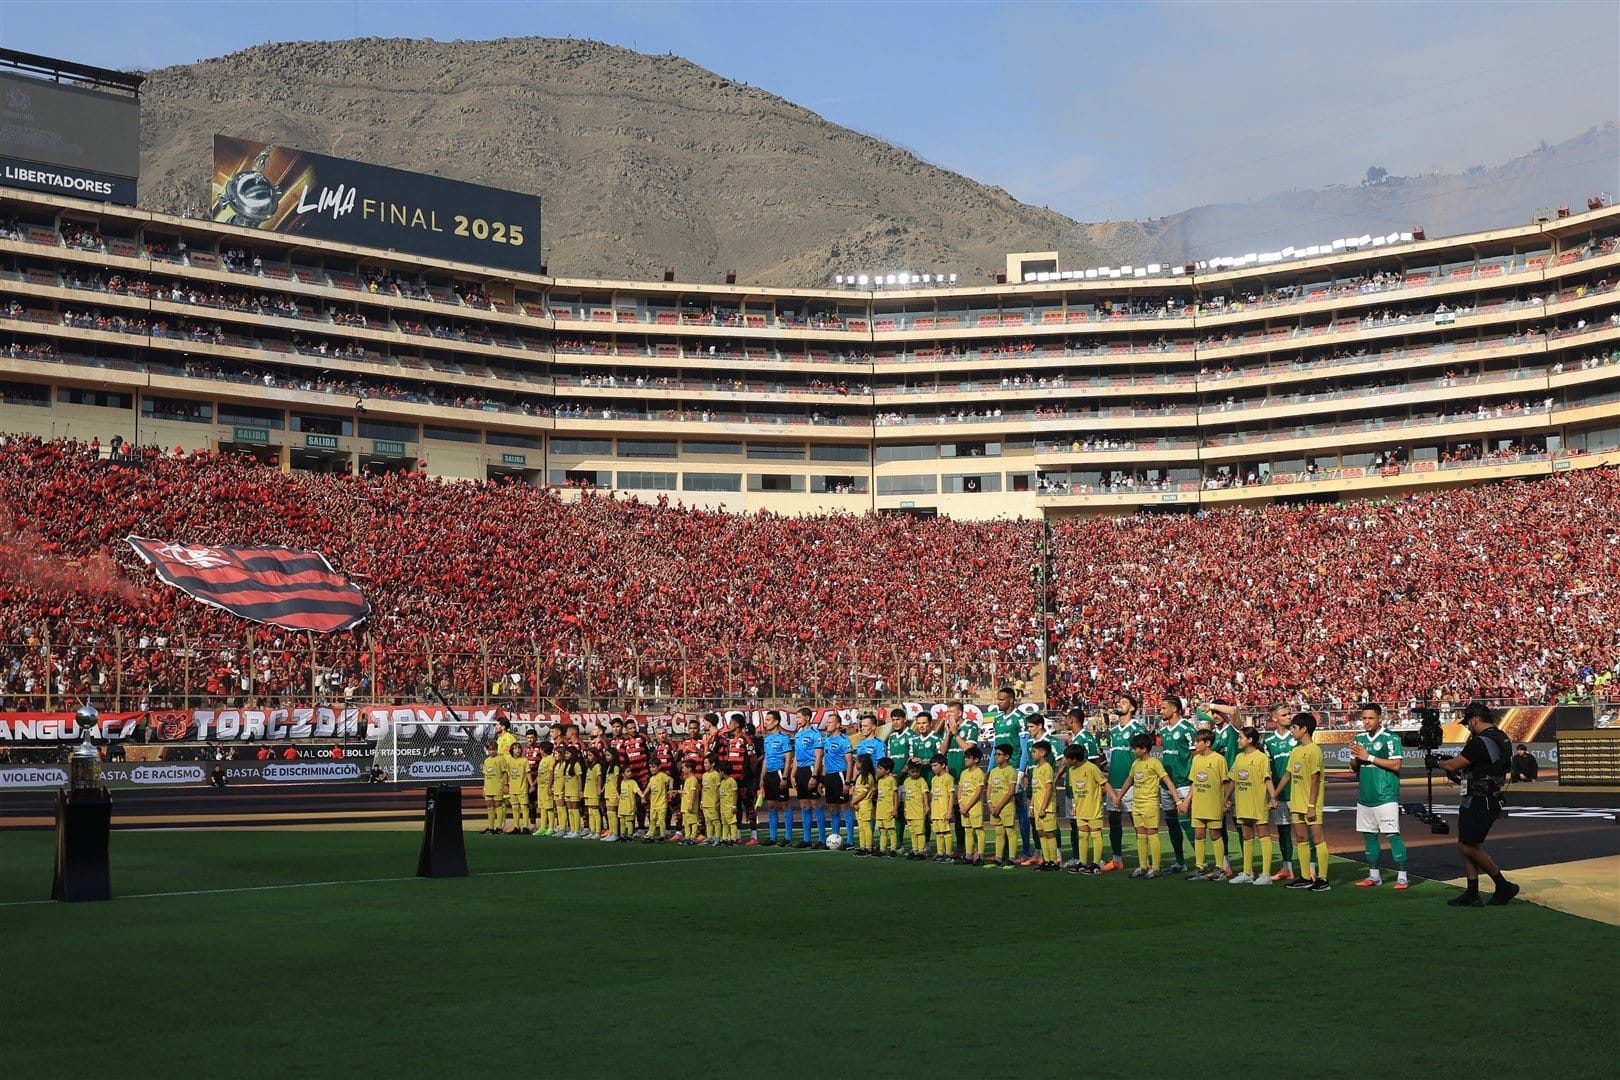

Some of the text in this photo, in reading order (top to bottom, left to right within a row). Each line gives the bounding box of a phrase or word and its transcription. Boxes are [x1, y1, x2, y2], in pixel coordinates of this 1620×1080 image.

[6, 166, 112, 194] LIBERTADORES
[296, 184, 524, 246] LIMA FINAL 2025
[237, 429, 266, 440] SALIDA
[308, 437, 336, 447] SALIDA
[376, 443, 402, 452] SALIDA
[226, 765, 358, 778] BASTA DE DISCRIMINACIÓN
[412, 765, 424, 773] DE
[426, 764, 472, 773] VIOLENCIA
[3, 773, 64, 782] VIOLENCIA
[100, 769, 201, 780] ASTA DE RACISMO
